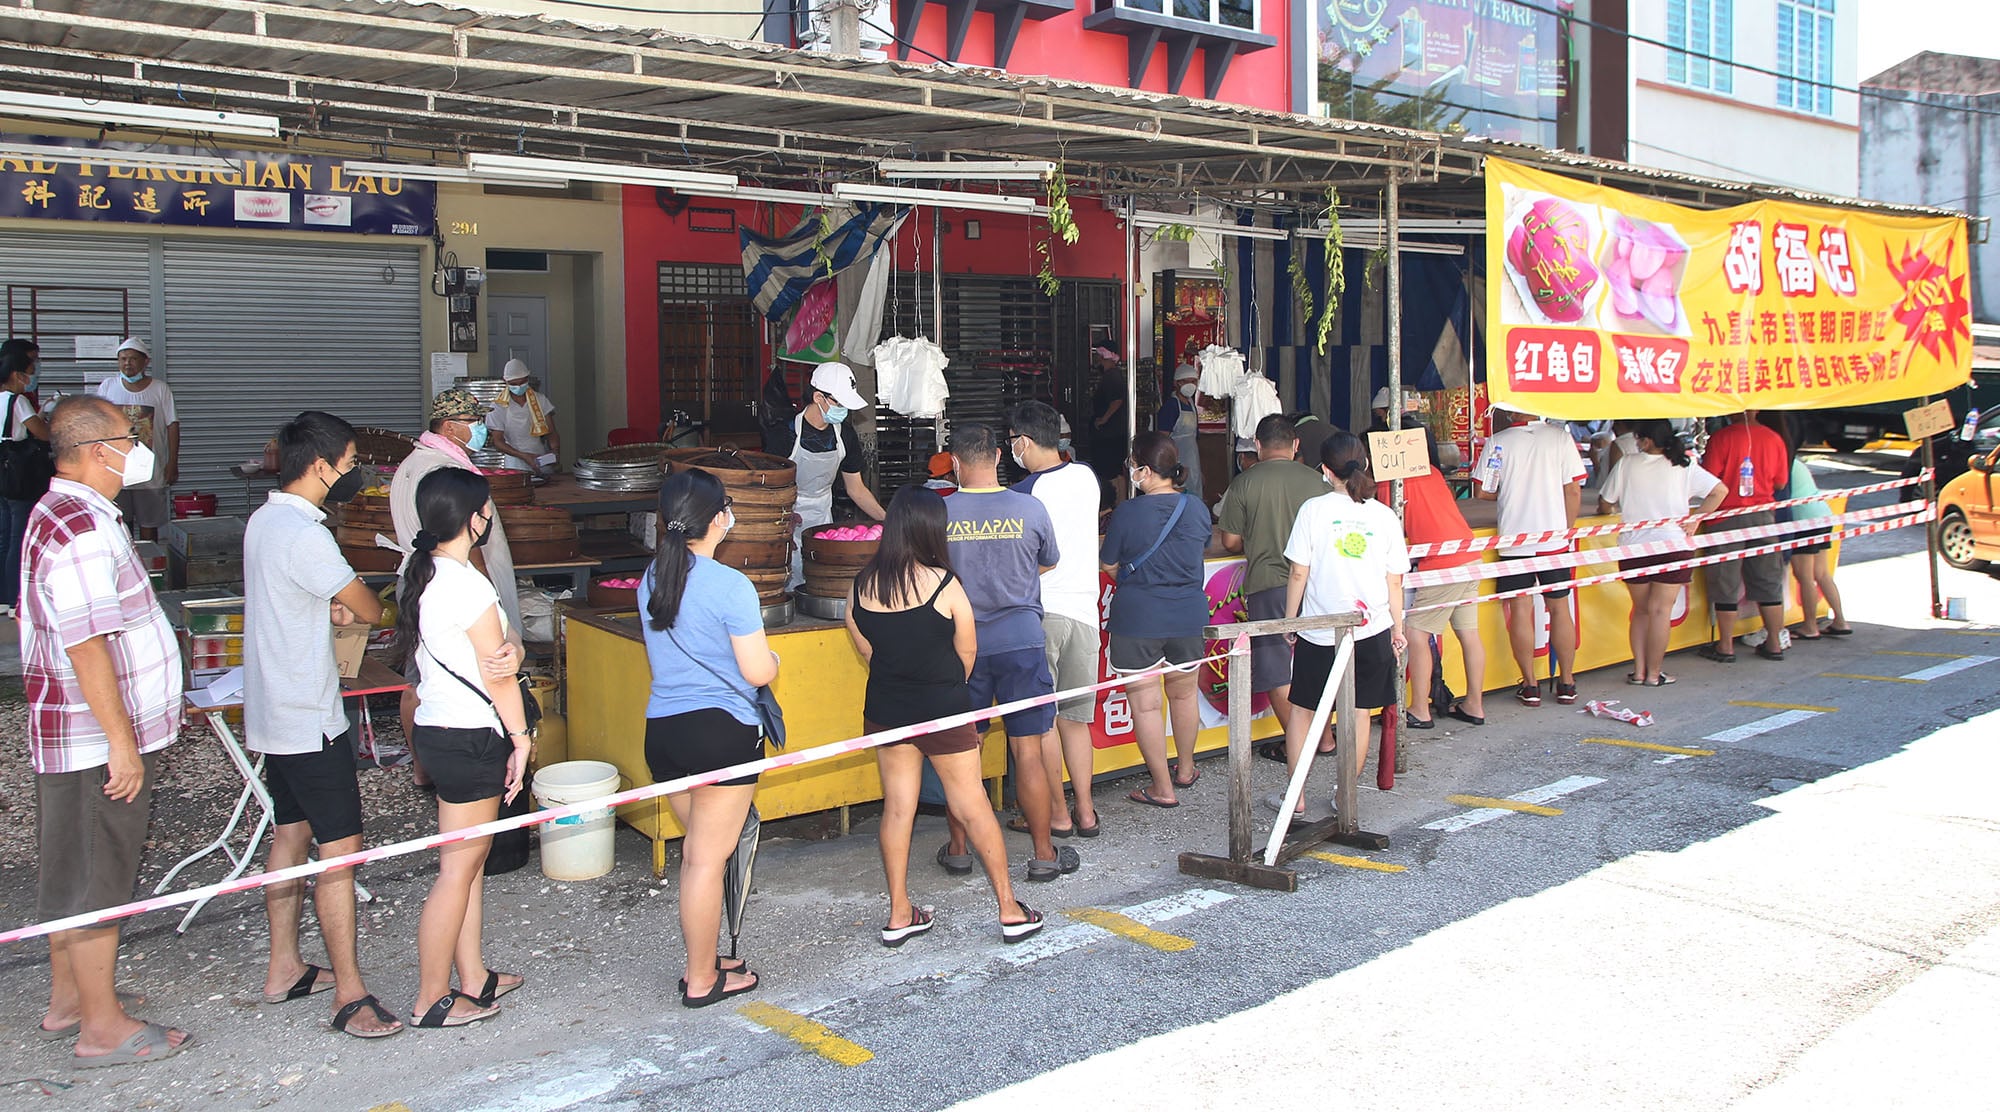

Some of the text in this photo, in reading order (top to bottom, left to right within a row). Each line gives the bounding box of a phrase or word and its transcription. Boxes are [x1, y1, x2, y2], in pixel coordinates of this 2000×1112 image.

[330, 165, 403, 196] LAU
[451, 221, 478, 235] 294
[1723, 219, 1857, 298] 胡福记
[1514, 340, 1594, 383] 红龟包
[1618, 346, 1682, 385] 寿桃包
[1381, 451, 1406, 469] OUT
